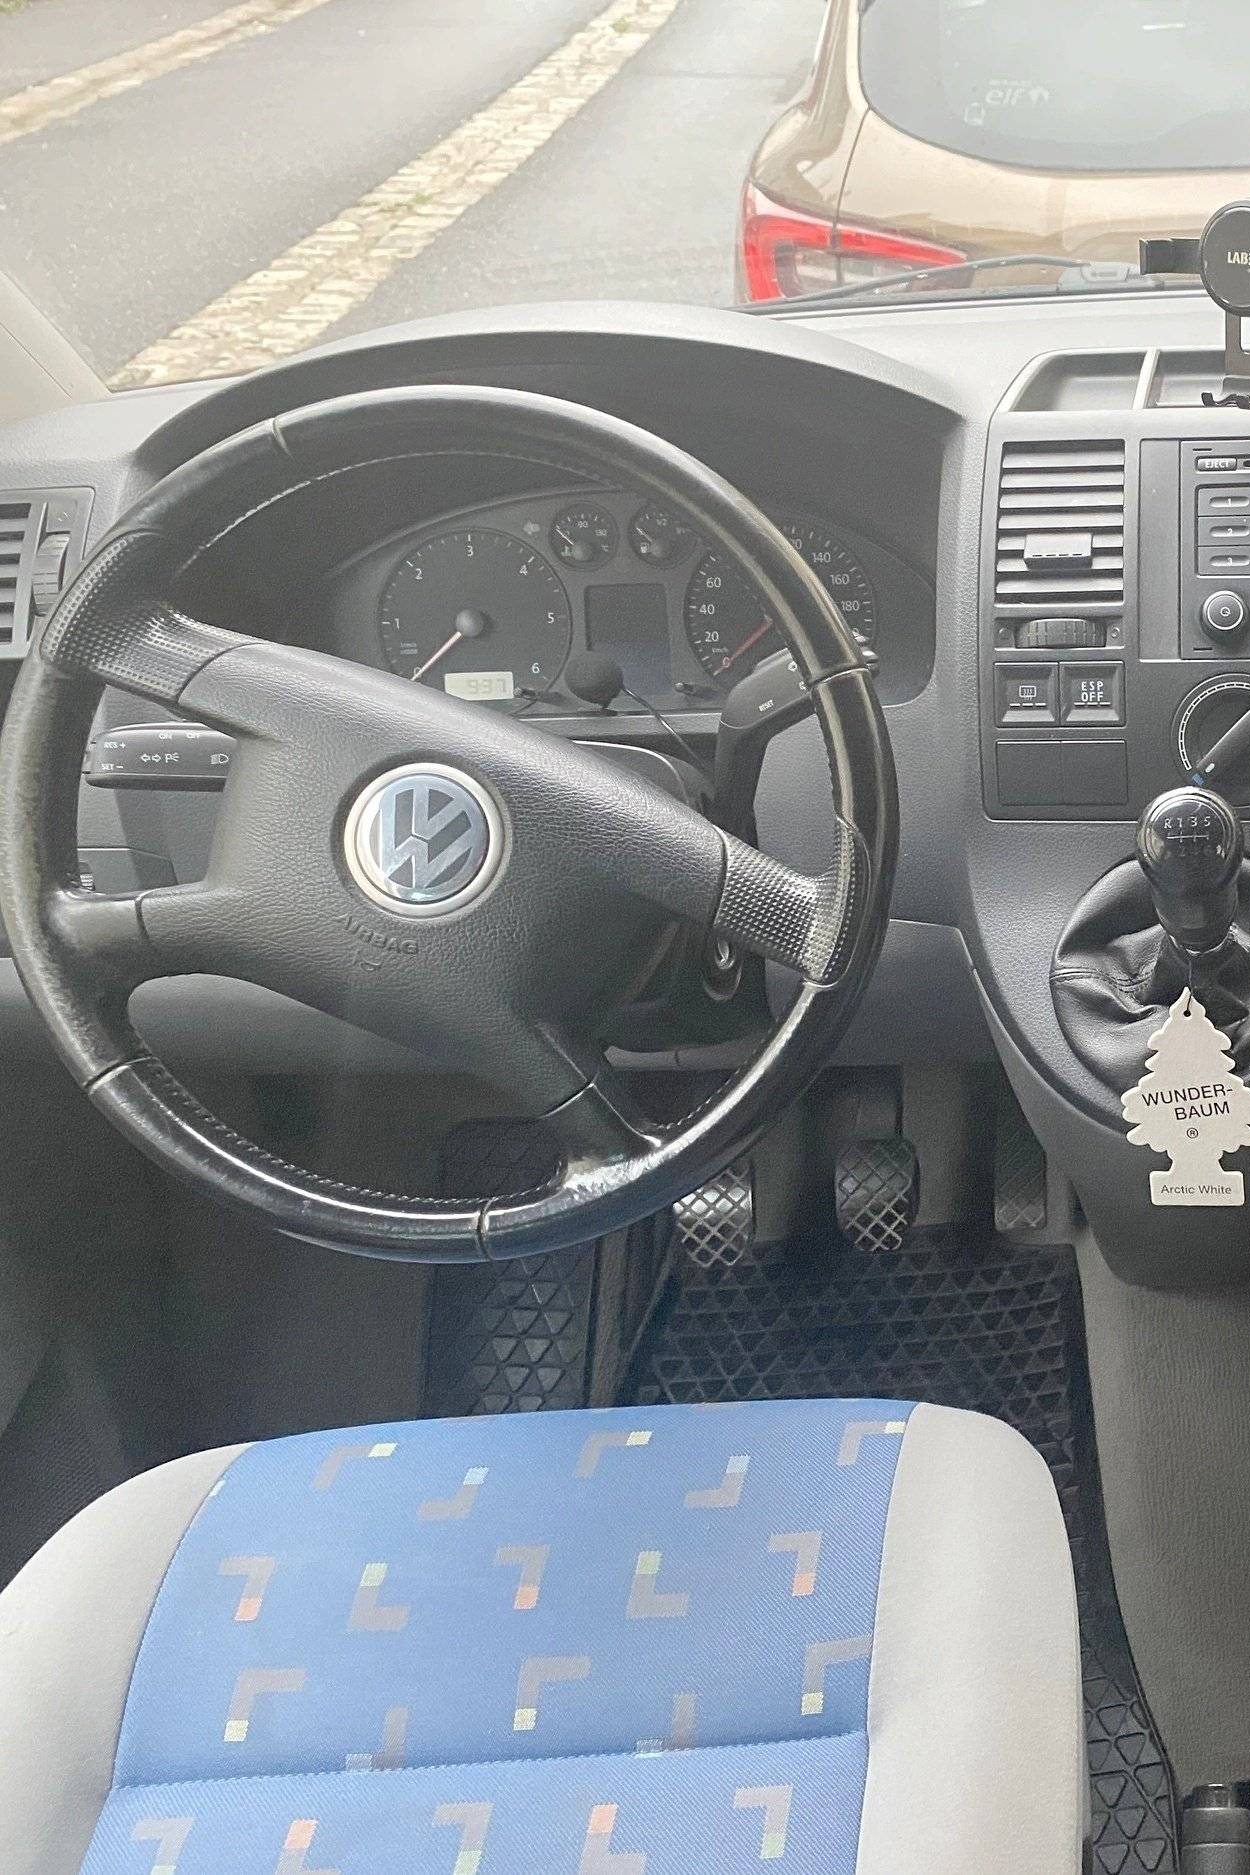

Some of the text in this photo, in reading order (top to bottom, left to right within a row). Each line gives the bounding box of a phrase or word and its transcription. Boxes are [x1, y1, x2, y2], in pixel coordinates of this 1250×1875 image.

[1205, 459, 1230, 468] EJECT
[466, 546, 474, 557] 3
[812, 552, 831, 563] 140
[415, 569, 423, 580] 2
[519, 565, 528, 576] 4
[706, 577, 721, 588] 60
[829, 573, 850, 585] 160
[699, 604, 715, 615] 40
[841, 600, 860, 611] 180
[395, 618, 400, 629] 1
[547, 612, 554, 624] 5
[705, 631, 719, 642] 20
[532, 662, 540, 673] 6
[1081, 681, 1104, 691] ESP
[1081, 692, 1104, 702] OFF
[759, 699, 774, 712] RESET
[357, 774, 490, 902] VW
[1142, 1083, 1233, 1106] WUNDER-
[1174, 1101, 1230, 1120] BAUM
[1160, 1184, 1232, 1195] Arctic White
